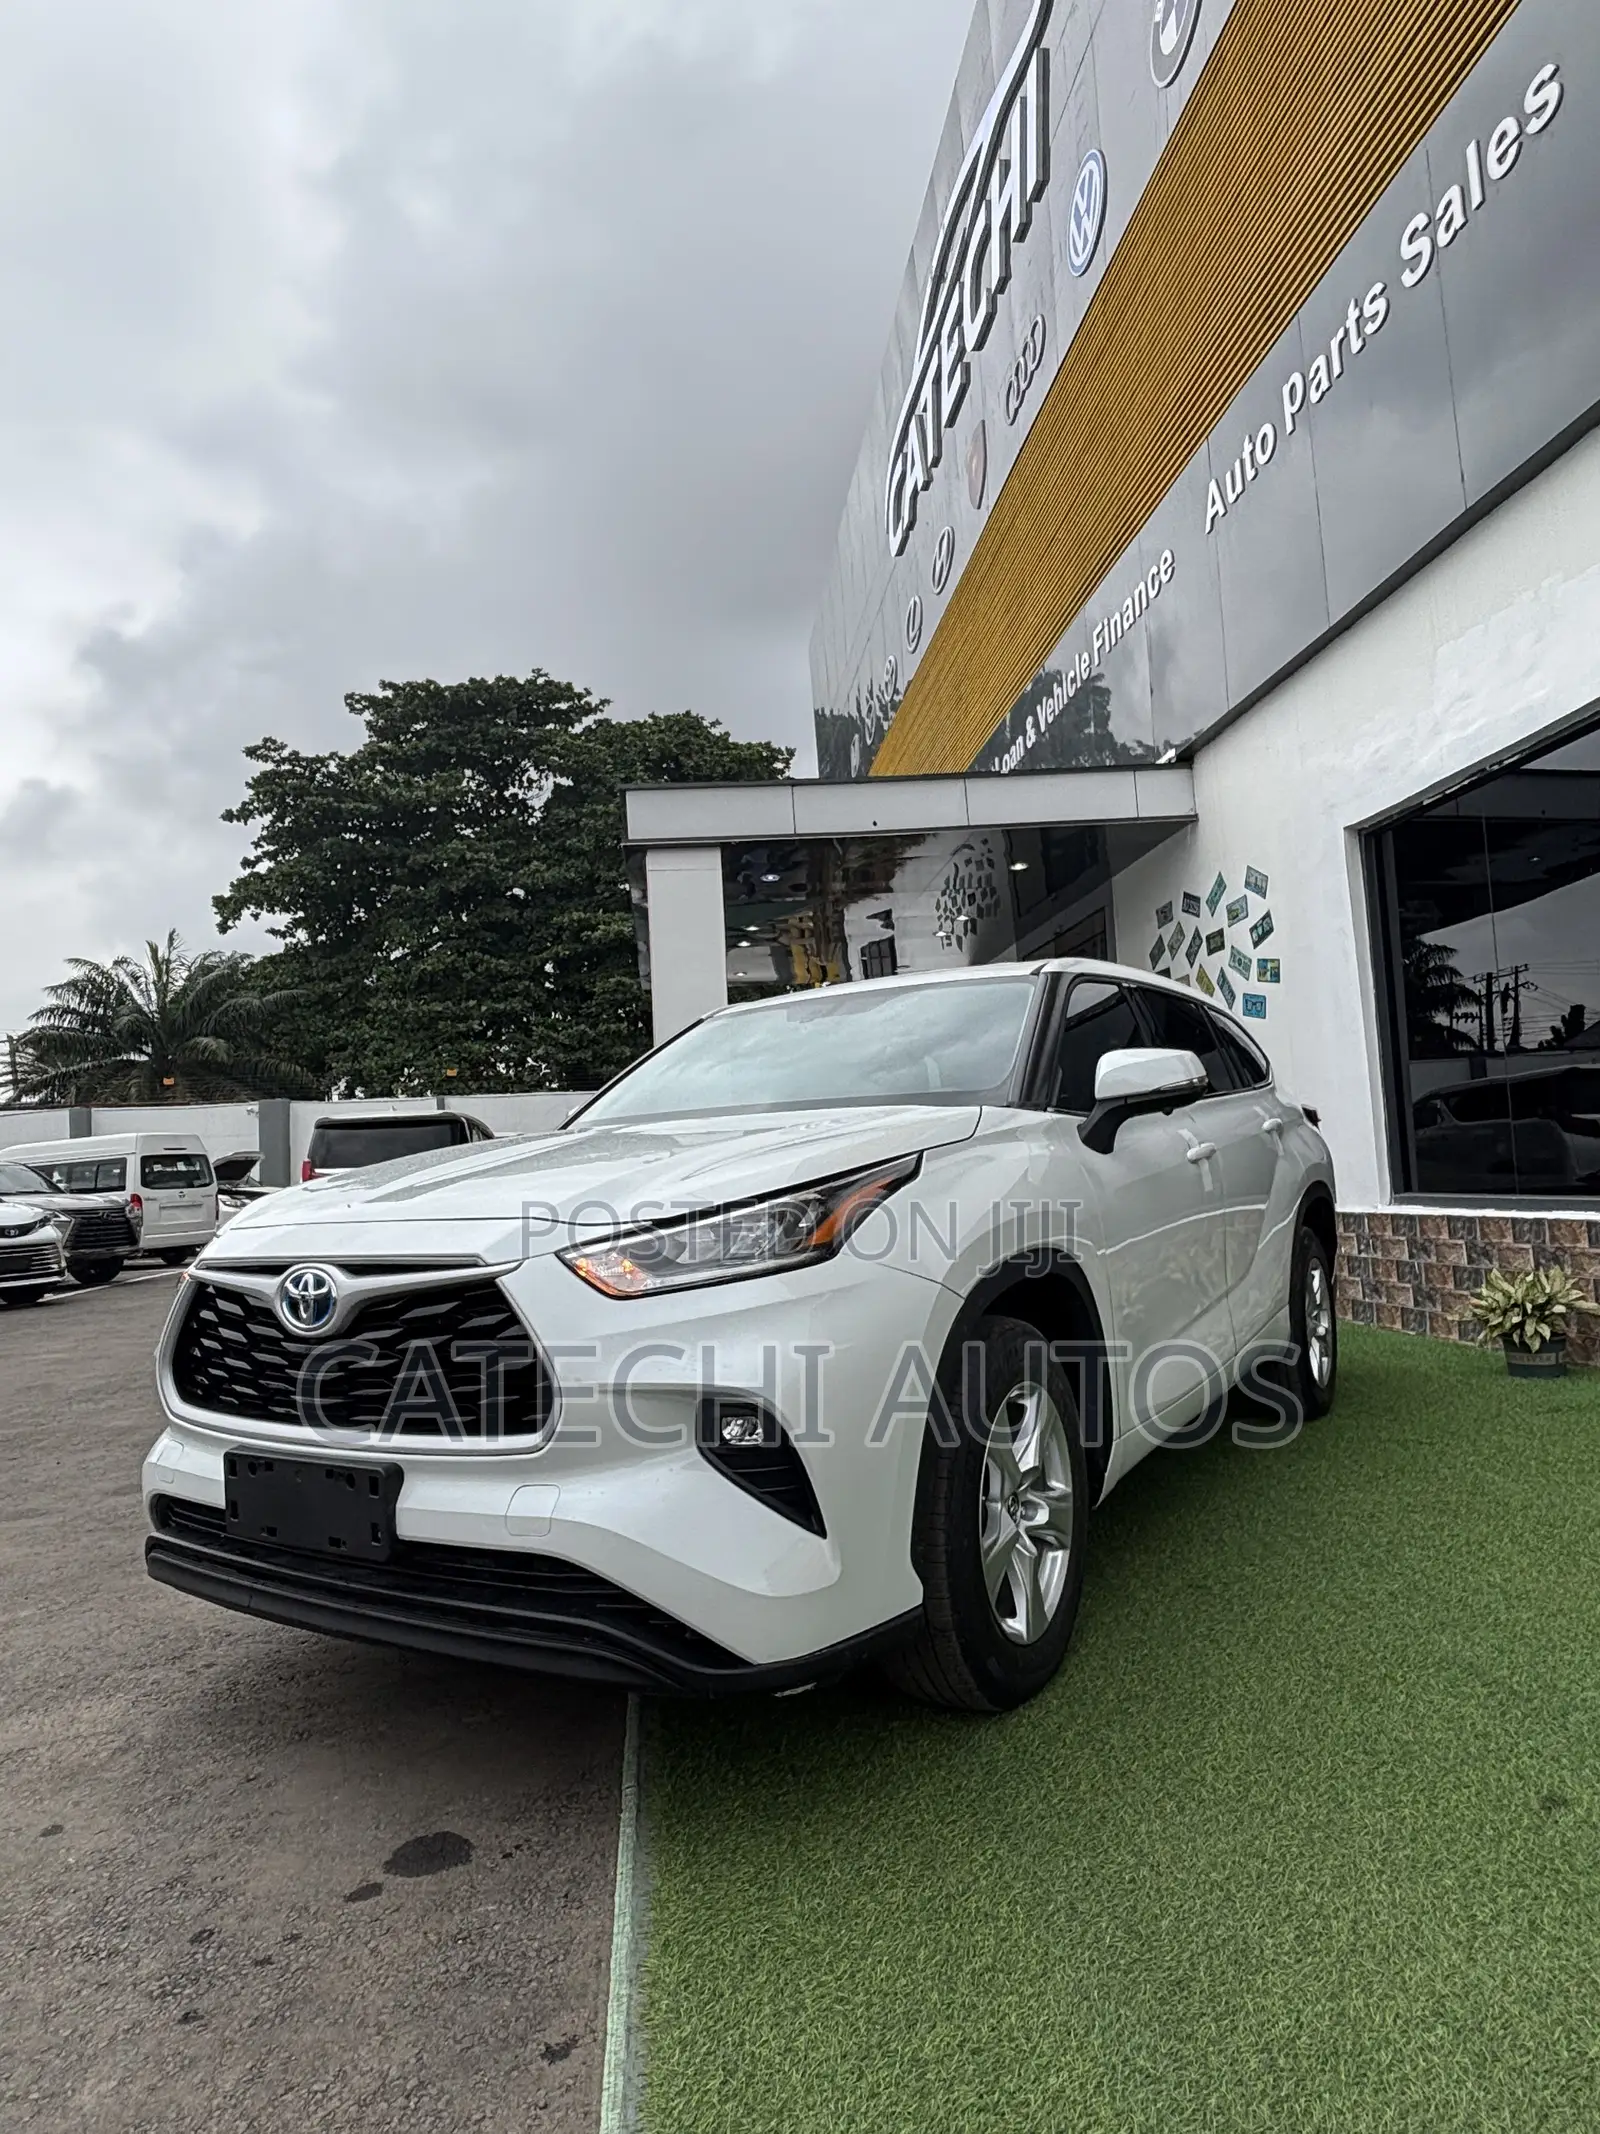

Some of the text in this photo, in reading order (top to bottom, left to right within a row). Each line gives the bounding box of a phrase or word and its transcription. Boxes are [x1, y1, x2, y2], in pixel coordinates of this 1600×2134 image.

[888, 47, 1051, 557] CATECHI
[1205, 422, 1277, 534] Auto
[1400, 63, 1563, 288] Sales
[1026, 715, 1036, 749] &
[1036, 652, 1091, 733] Vehicle
[1092, 549, 1175, 667] Finance
